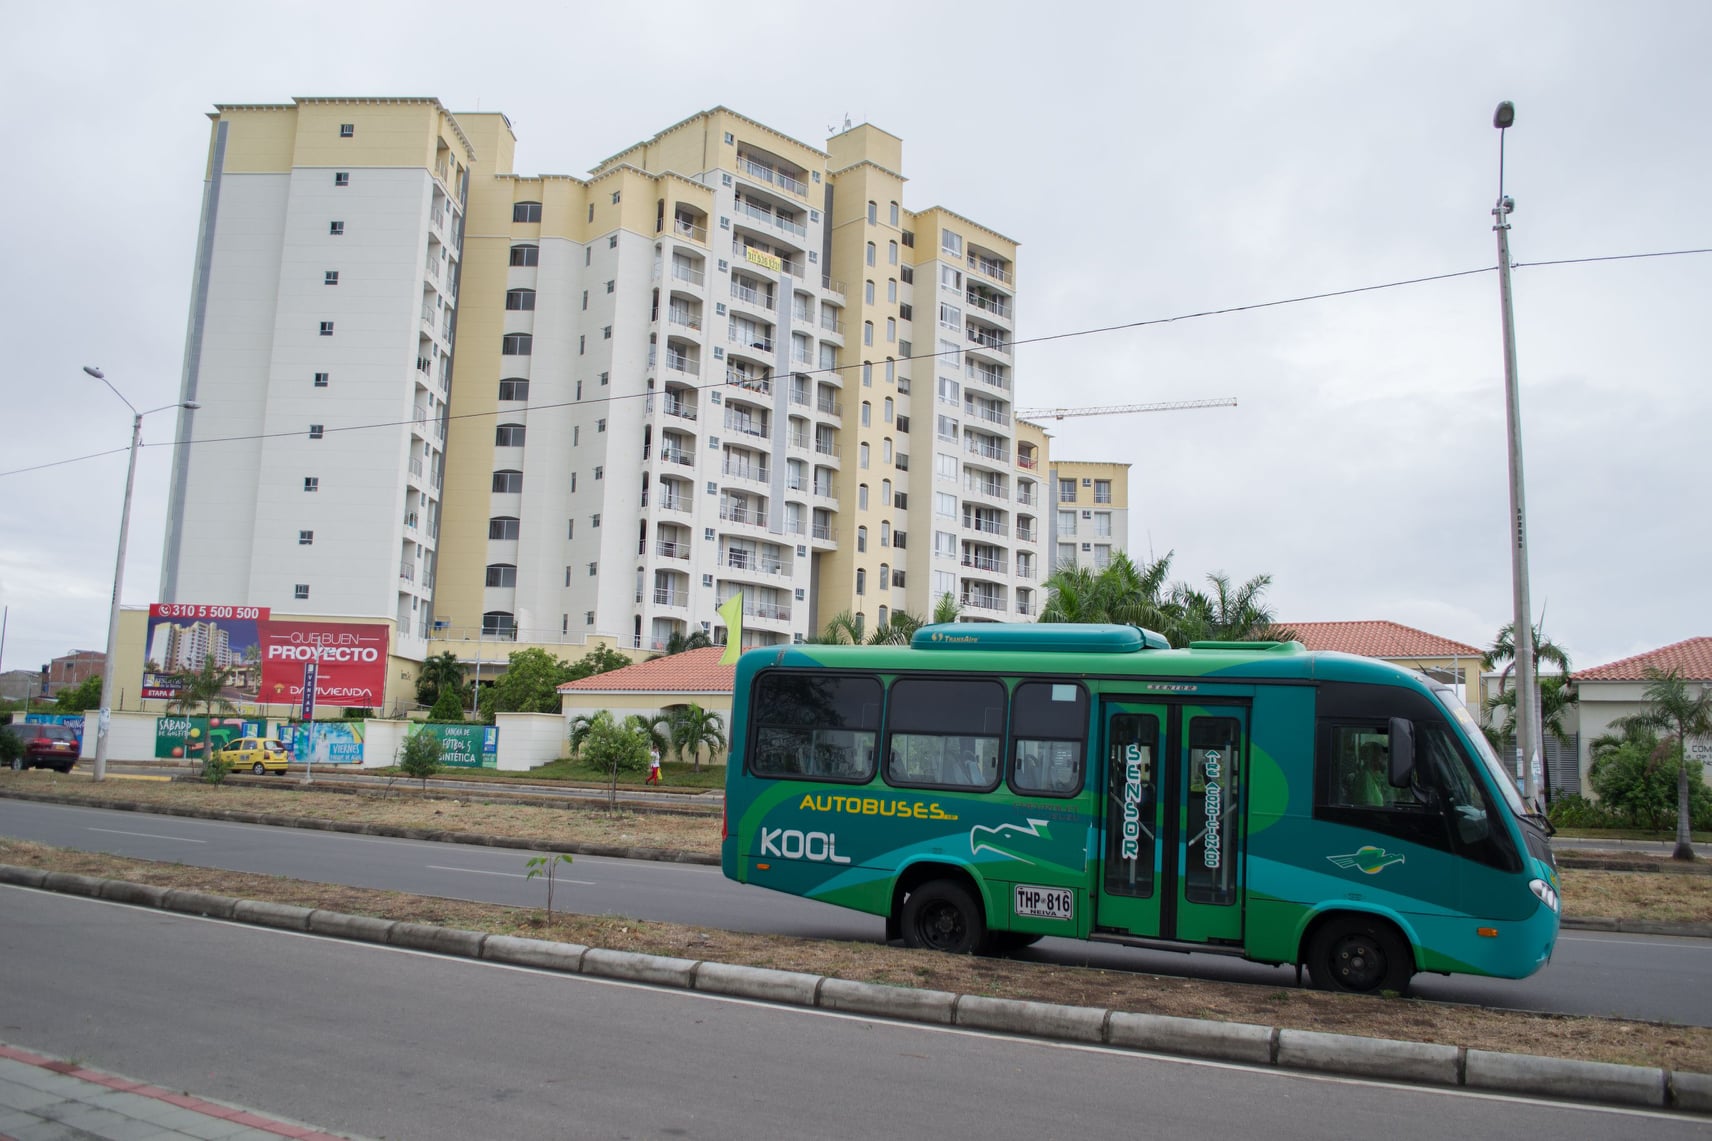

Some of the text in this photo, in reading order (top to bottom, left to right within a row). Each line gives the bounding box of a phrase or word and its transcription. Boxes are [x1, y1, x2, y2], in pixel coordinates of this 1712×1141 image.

[173, 604, 259, 619] 310 5 500 500
[290, 632, 360, 645] QUE BUEN
[268, 645, 378, 662] PROYECTO
[148, 689, 168, 697] ETAPA
[290, 686, 372, 697] DAIVIENDA
[304, 675, 313, 713] VENTAS
[333, 743, 360, 754] VIERNES
[800, 794, 944, 820] AUTOBUSES
[1122, 744, 1142, 860] SENSOR
[1204, 749, 1221, 868] AIRE ACONDICIONADO
[761, 827, 851, 864] KOOL
[1018, 890, 1070, 912] THP 816
